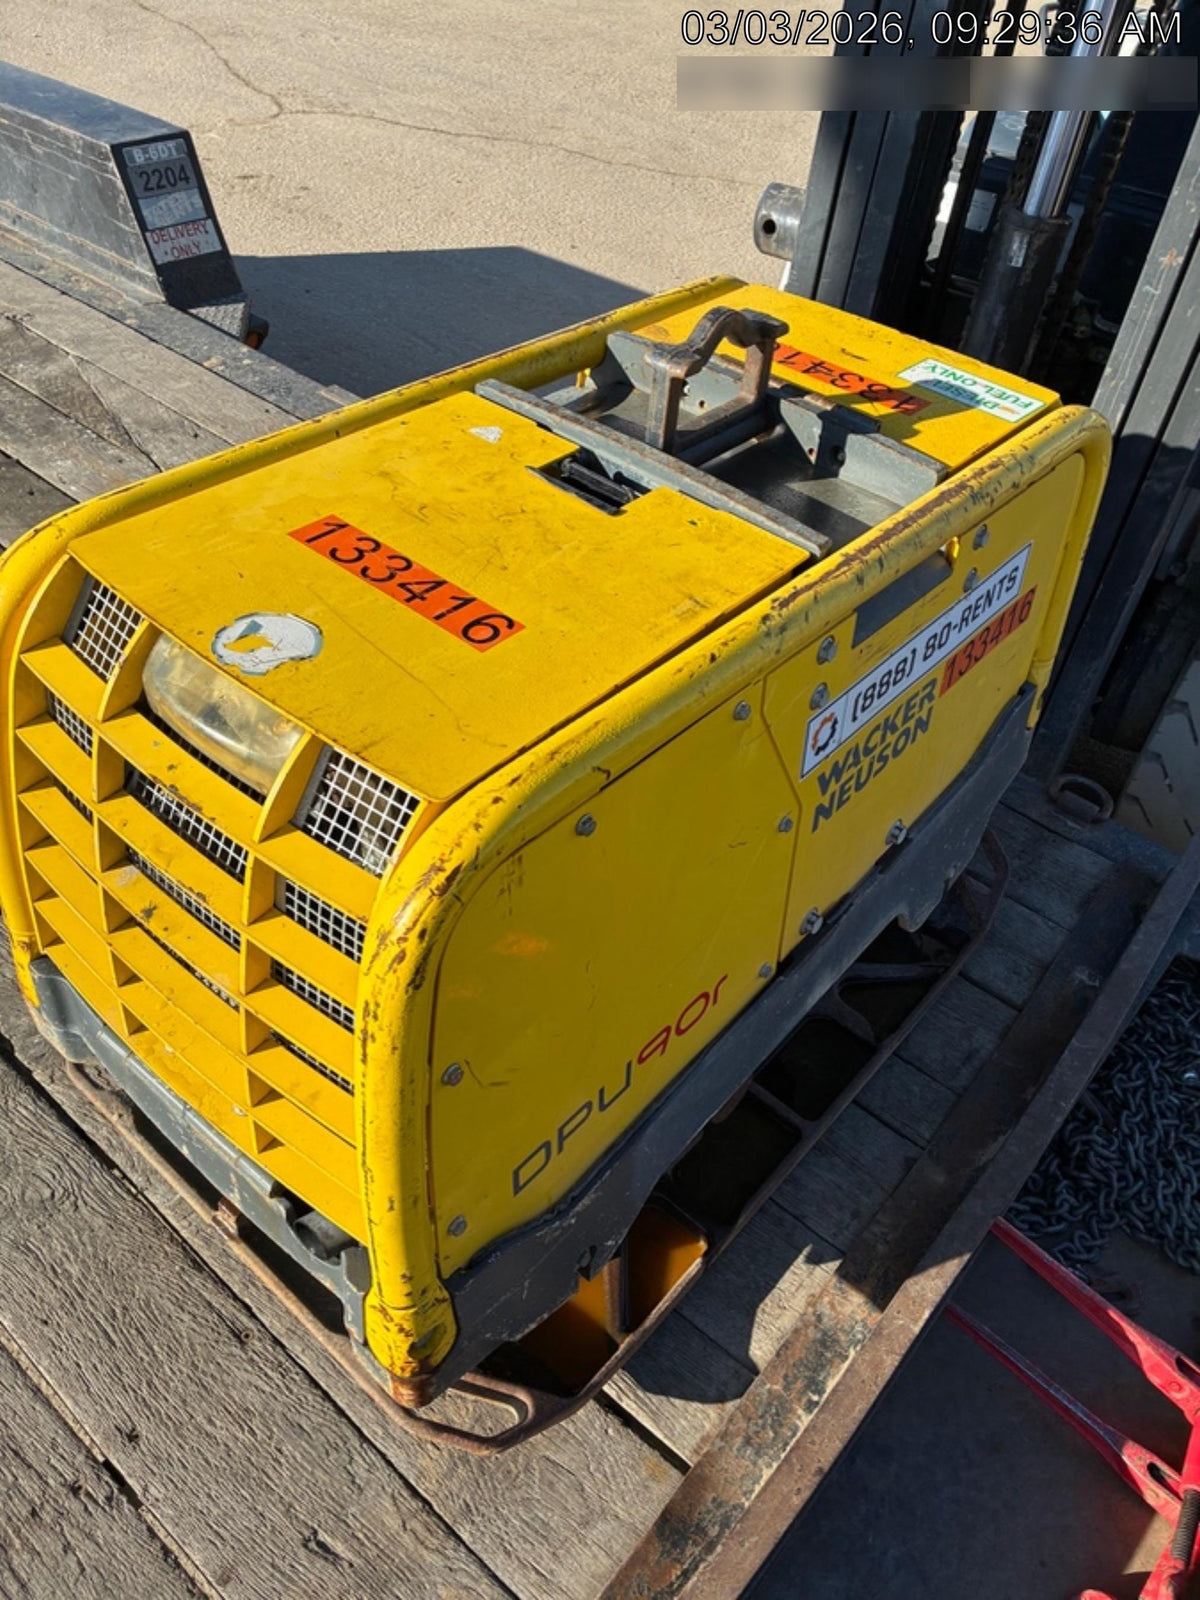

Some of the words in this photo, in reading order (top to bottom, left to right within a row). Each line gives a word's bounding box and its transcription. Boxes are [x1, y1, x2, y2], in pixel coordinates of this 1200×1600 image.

[139, 165, 190, 192] 2204
[150, 220, 209, 245] DELIVERY
[170, 242, 201, 259] ONLY
[775, 343, 918, 411] 13341
[926, 362, 977, 386] ONLY
[983, 383, 1035, 409] FUEL
[304, 521, 515, 645] 133416
[946, 592, 1035, 688] 133416
[816, 677, 939, 797] WACKER
[811, 706, 934, 833] NEUSON
